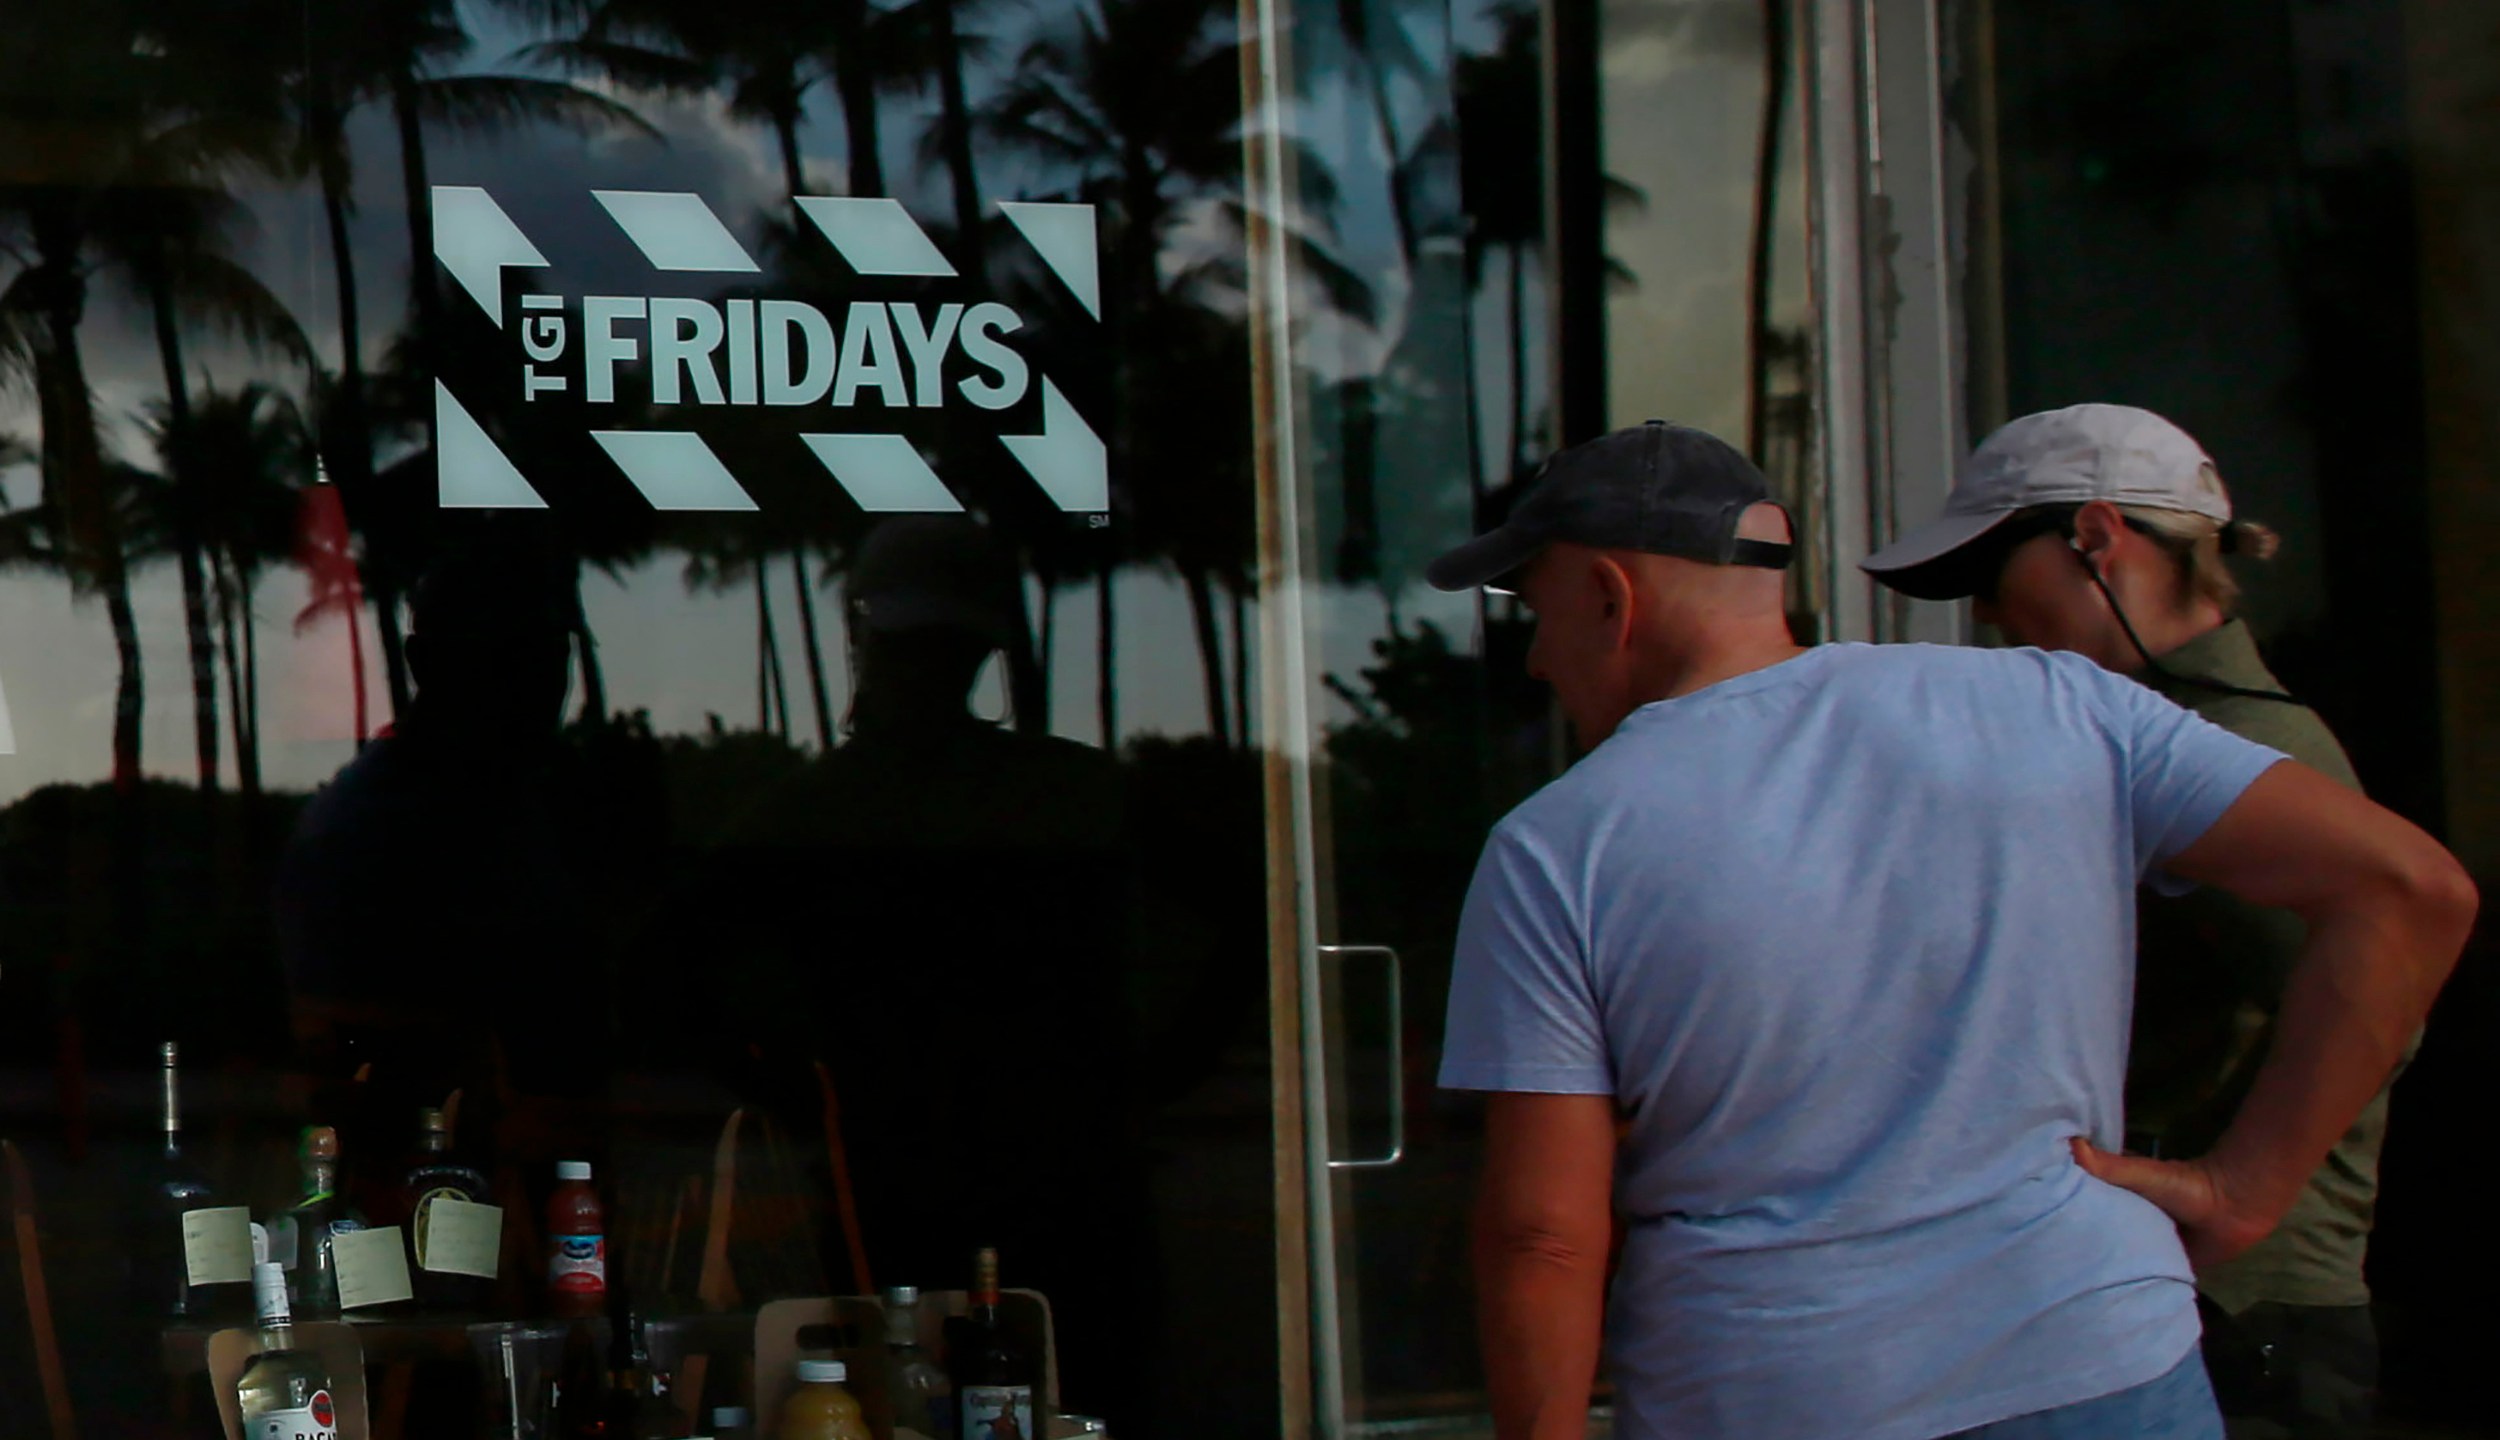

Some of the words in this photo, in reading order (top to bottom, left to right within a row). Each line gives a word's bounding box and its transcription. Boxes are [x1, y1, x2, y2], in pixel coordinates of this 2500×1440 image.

[521, 294, 567, 402] TGI
[583, 295, 1029, 410] FRIDAYS
[1088, 513, 1111, 529] SM
